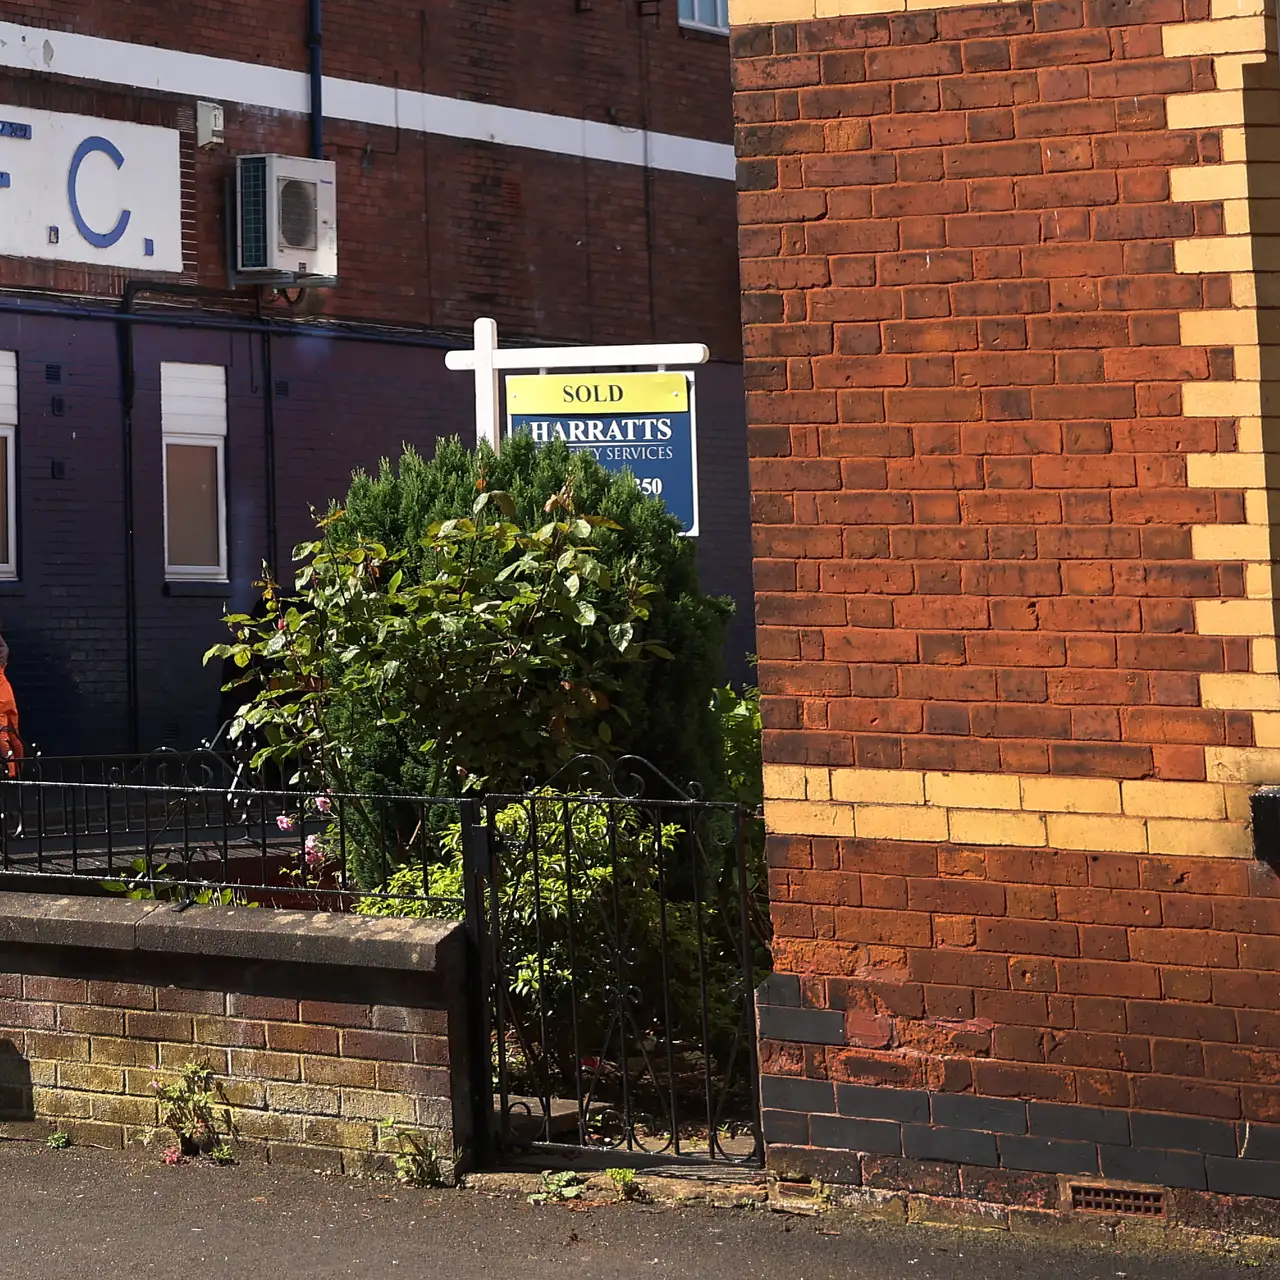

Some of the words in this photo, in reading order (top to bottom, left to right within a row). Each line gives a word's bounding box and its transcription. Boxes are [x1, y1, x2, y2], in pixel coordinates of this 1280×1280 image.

[563, 384, 624, 403] SOLD
[529, 418, 673, 442] HARRATTS
[606, 446, 673, 460] SERVICES
